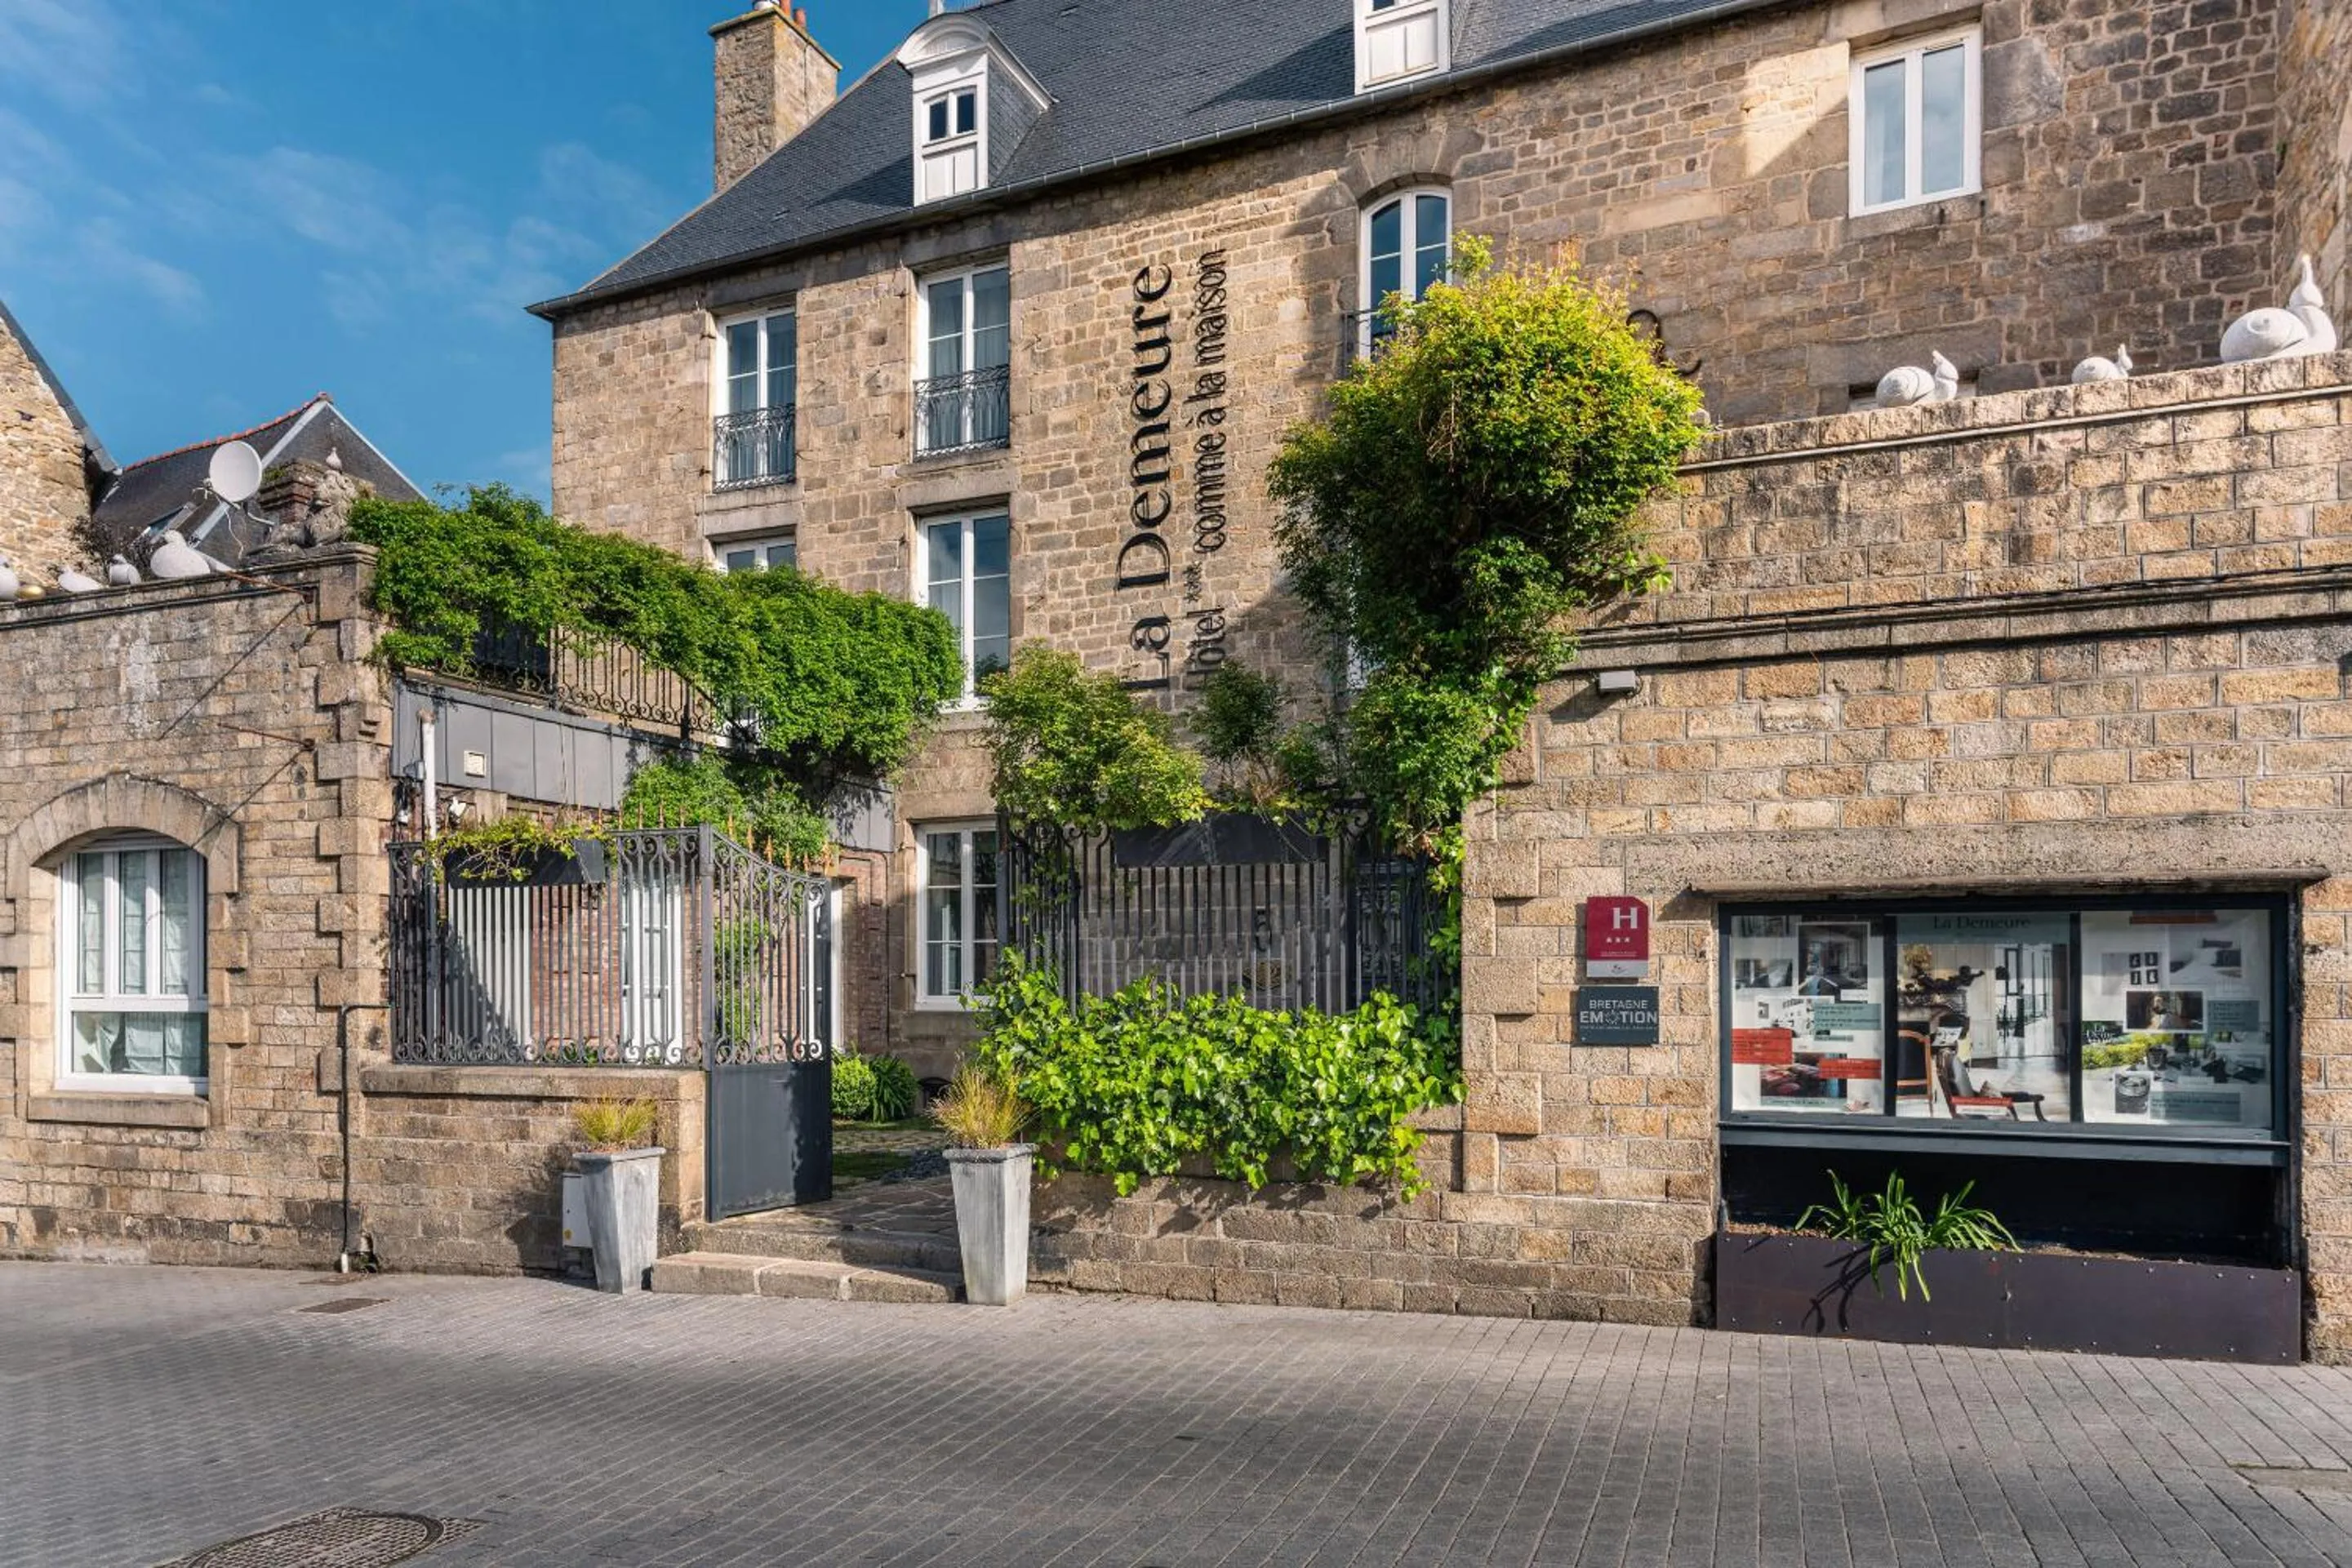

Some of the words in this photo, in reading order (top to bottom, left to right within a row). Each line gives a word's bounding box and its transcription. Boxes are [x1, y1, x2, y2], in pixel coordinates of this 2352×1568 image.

[1187, 247, 1227, 368] maison
[1184, 371, 1226, 404] la
[1114, 262, 1172, 592] Demeure
[1185, 407, 1226, 429] à
[1194, 433, 1226, 553] comme
[1119, 610, 1172, 690] La
[1612, 907, 1638, 930] H
[1934, 915, 1951, 929] La
[1957, 915, 2031, 929] Demeure
[1589, 999, 1648, 1009] BRETAGNE
